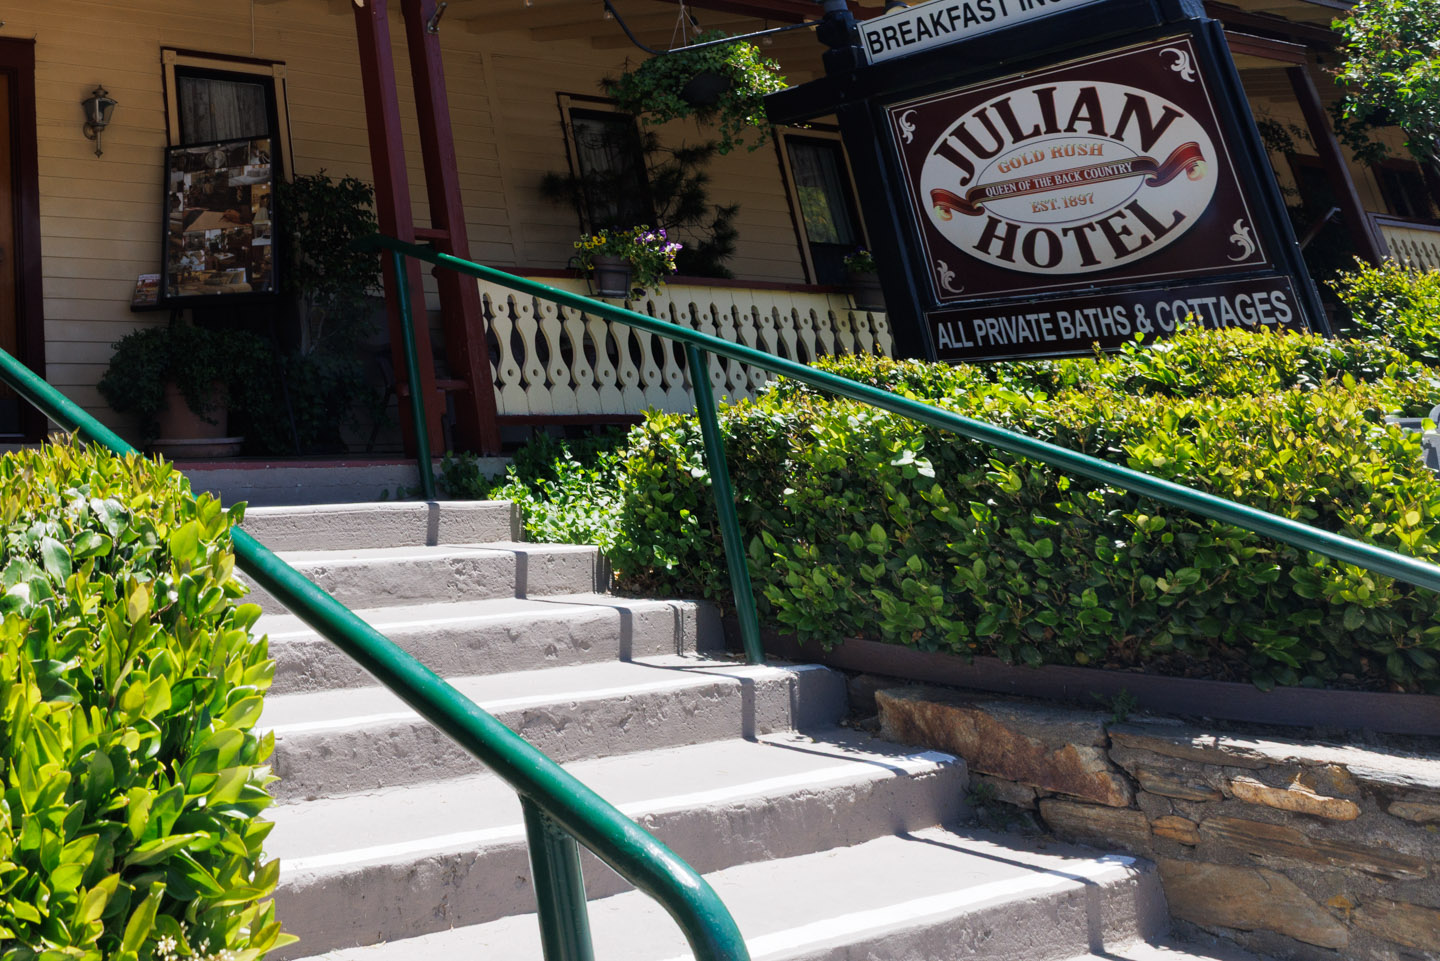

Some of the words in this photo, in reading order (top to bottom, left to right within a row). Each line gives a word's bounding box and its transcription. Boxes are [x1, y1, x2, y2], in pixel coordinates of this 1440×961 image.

[934, 86, 1184, 186] JULIAN
[997, 149, 1045, 174] GOLD
[1050, 143, 1104, 159] RUSH
[985, 183, 1017, 197] QUEEN
[1018, 180, 1031, 191] OF
[1033, 178, 1054, 189] THE
[1055, 172, 1083, 186] BACK
[1084, 162, 1133, 179] COUNTRY
[1062, 192, 1094, 208] 1897
[972, 199, 1186, 268] HOTEL
[937, 321, 973, 349] ALL
[973, 312, 1056, 346] PRIVATE
[1060, 305, 1131, 339] BATHS
[1135, 303, 1154, 333] &
[1155, 290, 1292, 331] COTTAGES
